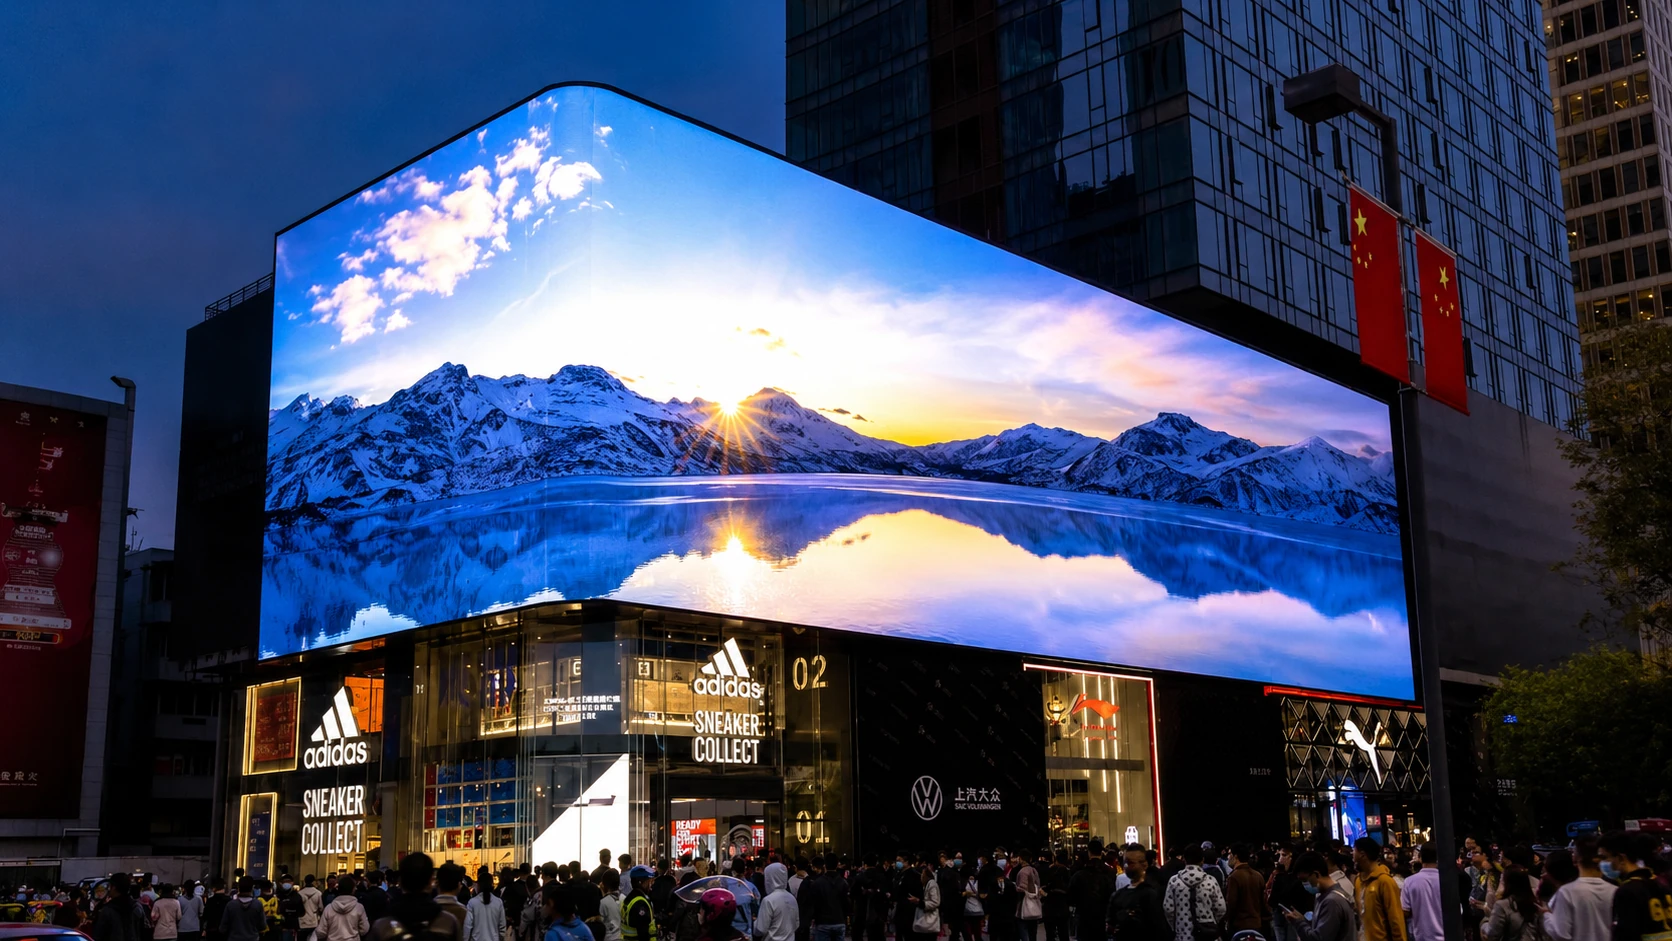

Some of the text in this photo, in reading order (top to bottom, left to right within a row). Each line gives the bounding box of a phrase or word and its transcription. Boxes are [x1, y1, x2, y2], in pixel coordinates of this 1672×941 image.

[694, 674, 761, 699] adidas
[793, 655, 828, 690] 02
[694, 710, 760, 736] SNEAKER
[303, 737, 367, 769] adidas
[694, 736, 760, 764] COLLECT
[302, 785, 364, 818] SNEAKER
[954, 787, 1001, 802] 上汽大众
[301, 820, 363, 855] COLLECT
[675, 819, 701, 830] READY
[796, 810, 830, 843] 01
